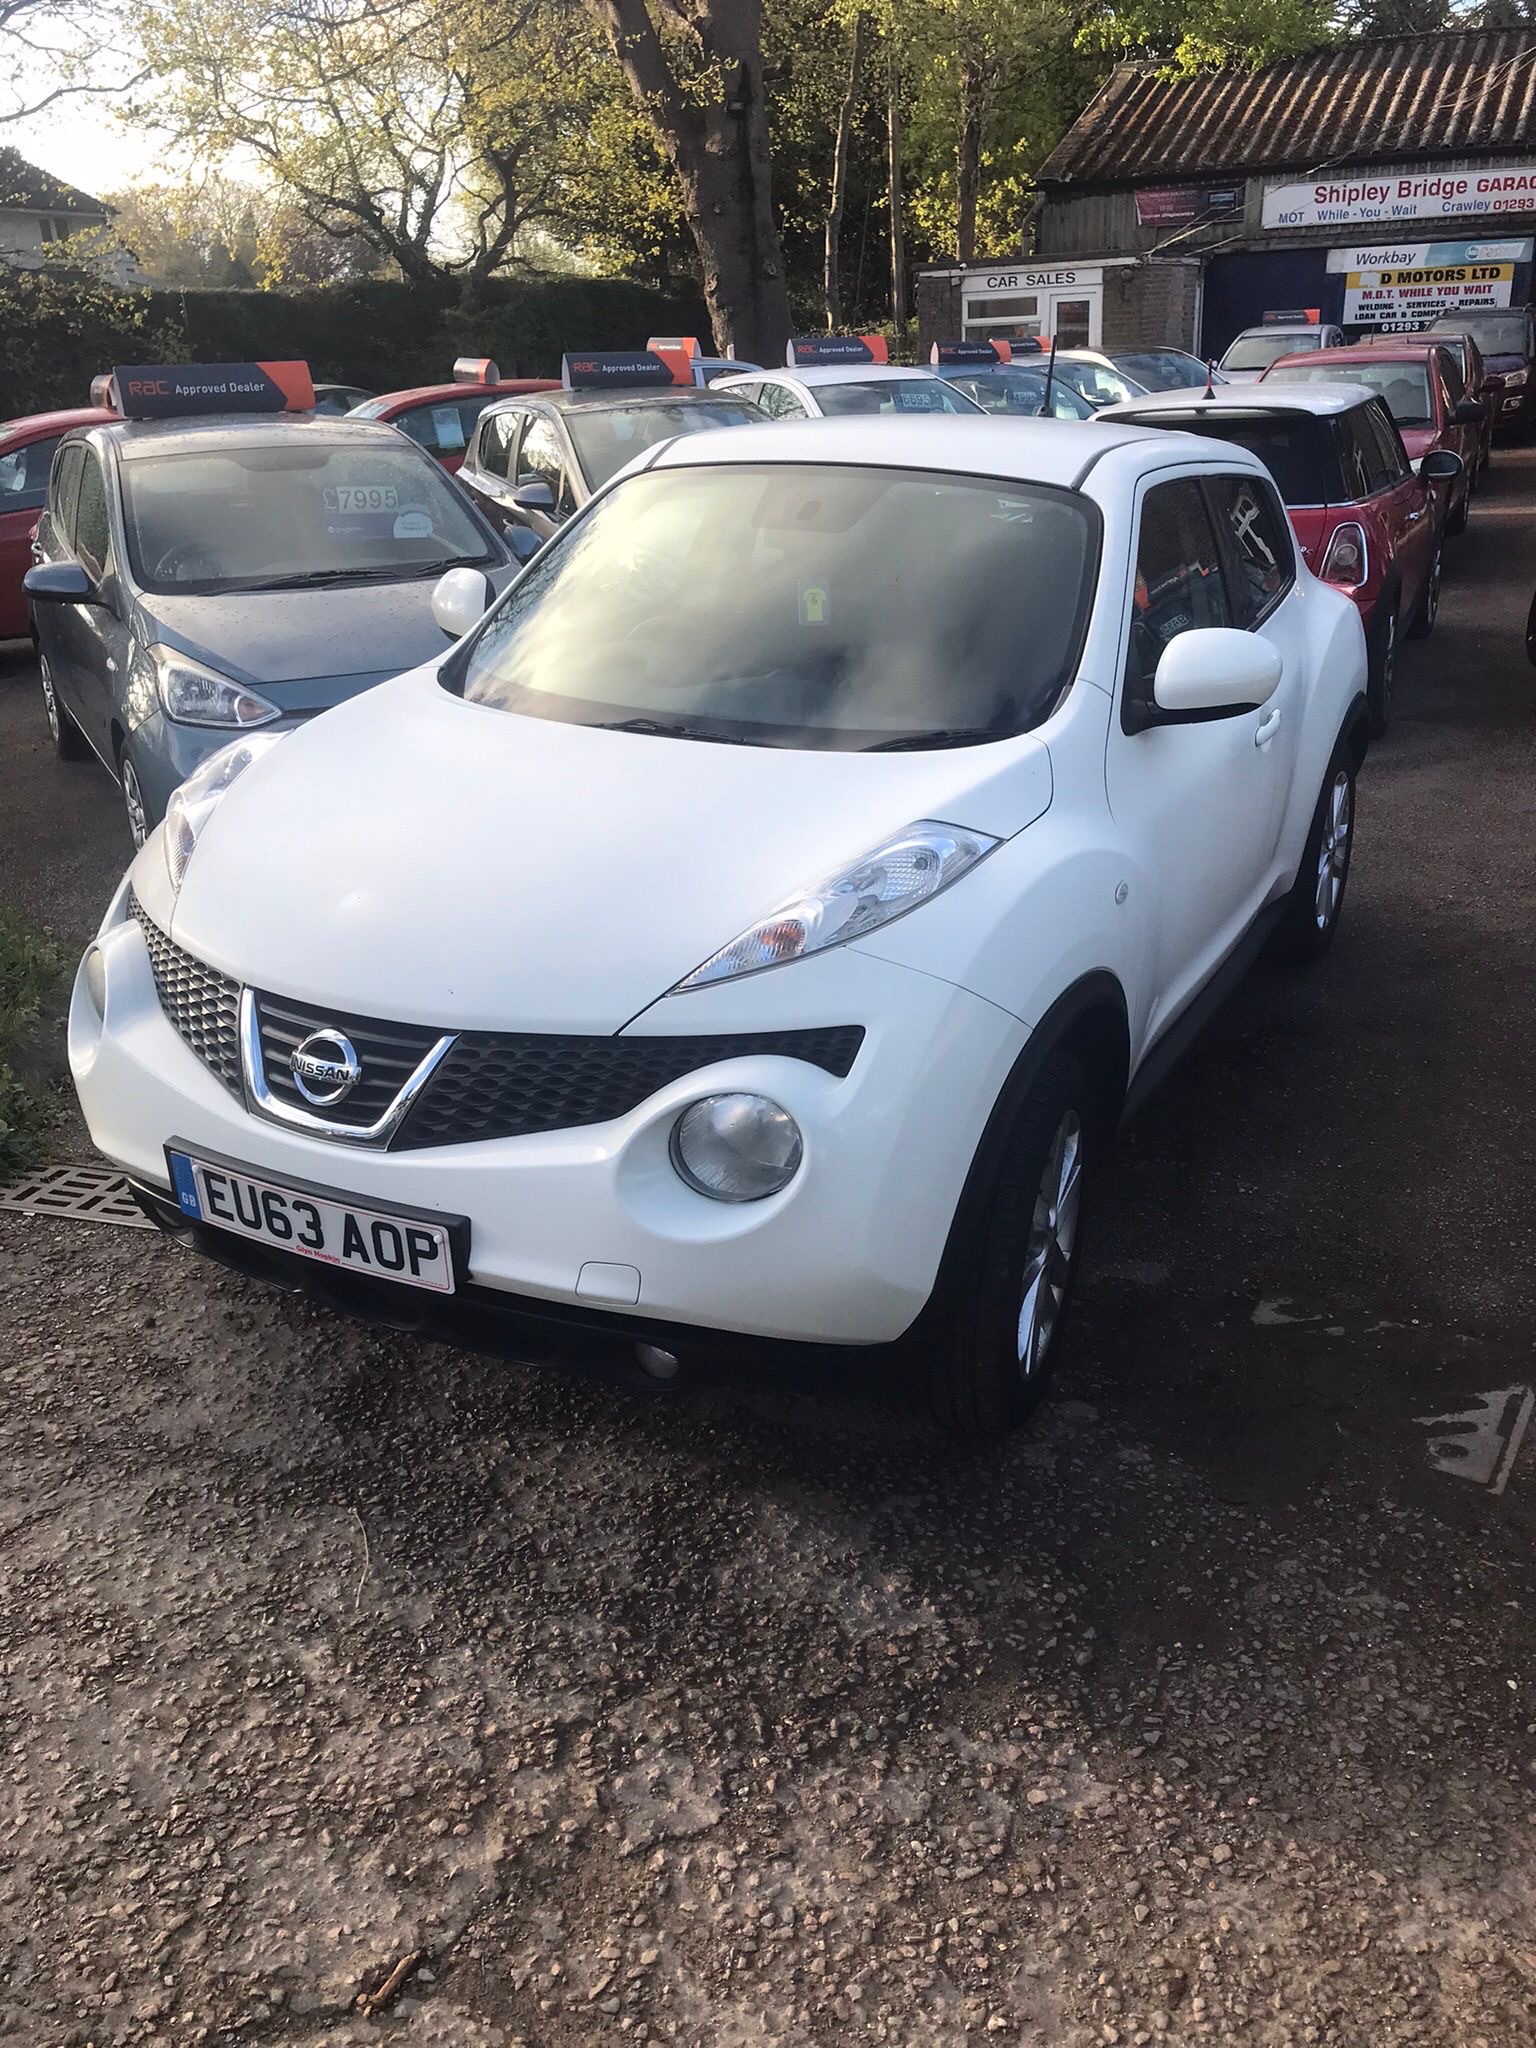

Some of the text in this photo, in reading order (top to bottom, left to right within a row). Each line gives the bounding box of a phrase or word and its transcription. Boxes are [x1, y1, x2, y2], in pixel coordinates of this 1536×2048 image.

[1314, 183, 1390, 206] Shipley
[1397, 178, 1468, 200] Bridge
[1278, 198, 1534, 224] MOT While You Wait Crawley 01293
[1356, 251, 1416, 266] Workbay
[987, 272, 1076, 289] CAR SALES
[1397, 269, 1466, 284] MOTORS
[1472, 266, 1500, 280] LTD
[1399, 286, 1433, 298] WHILE
[1437, 285, 1460, 296] YOU
[1463, 284, 1494, 295] WAIT
[1358, 297, 1495, 311] WELDING SERVICES REPAIRS
[1354, 312, 1376, 320] LOAN
[1380, 311, 1397, 319] CAR
[1381, 321, 1420, 332] 01293
[819, 346, 845, 355] Approved
[602, 364, 635, 374] Approved
[636, 363, 660, 371] Dealer
[175, 383, 226, 397] Approved
[229, 381, 265, 393] Dealer
[323, 488, 397, 510] £7995
[290, 1054, 350, 1080] NISSAN
[181, 1191, 197, 1207] GB
[202, 1169, 438, 1276] EU63 AOP
